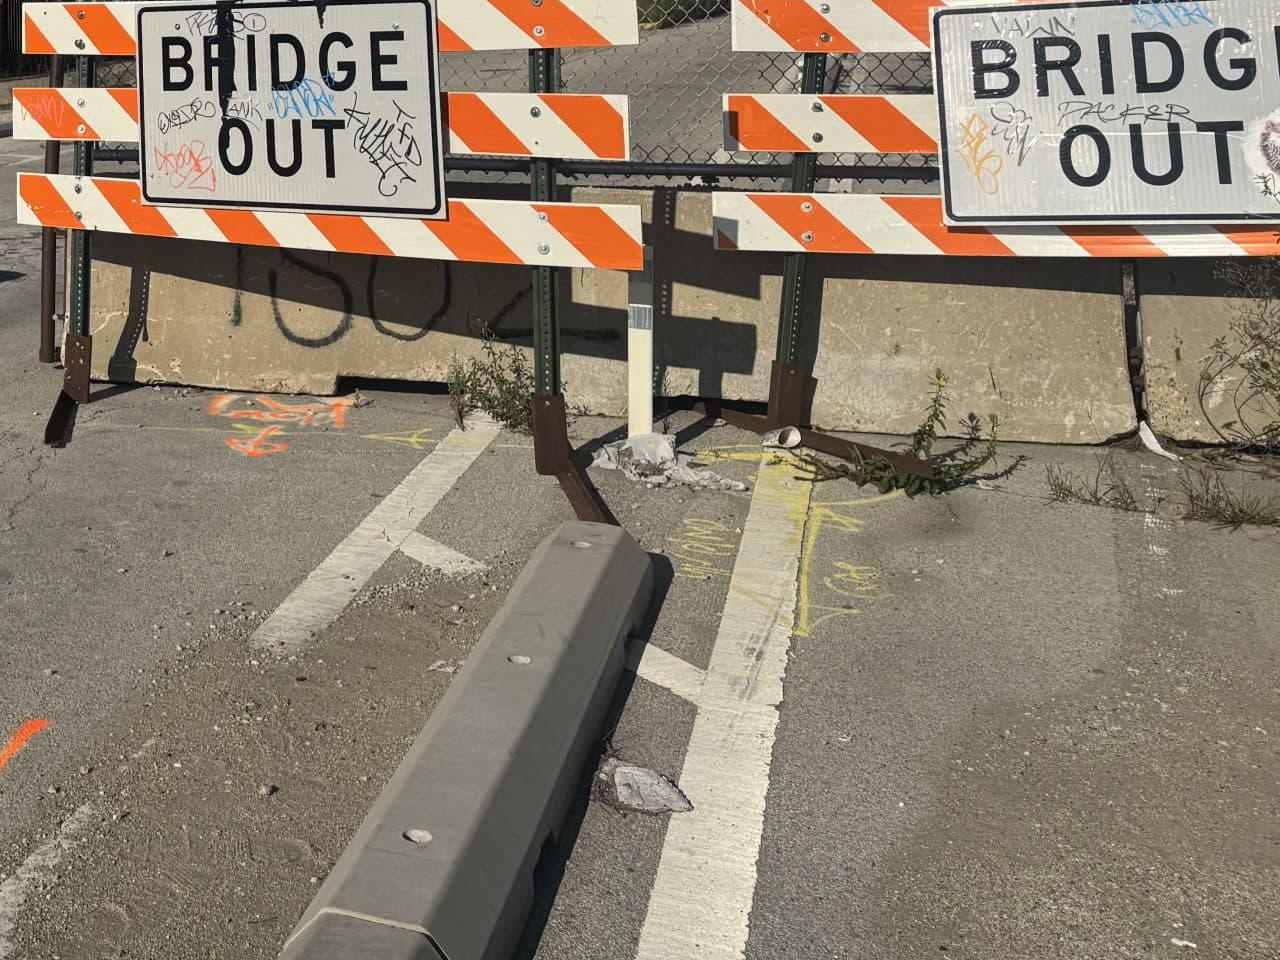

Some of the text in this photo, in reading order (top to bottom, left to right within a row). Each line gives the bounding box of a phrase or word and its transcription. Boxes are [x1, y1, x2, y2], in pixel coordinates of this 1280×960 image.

[970, 26, 1280, 99] BRIDG
[219, 118, 346, 179] OUT
[1059, 120, 1244, 187] OUT
